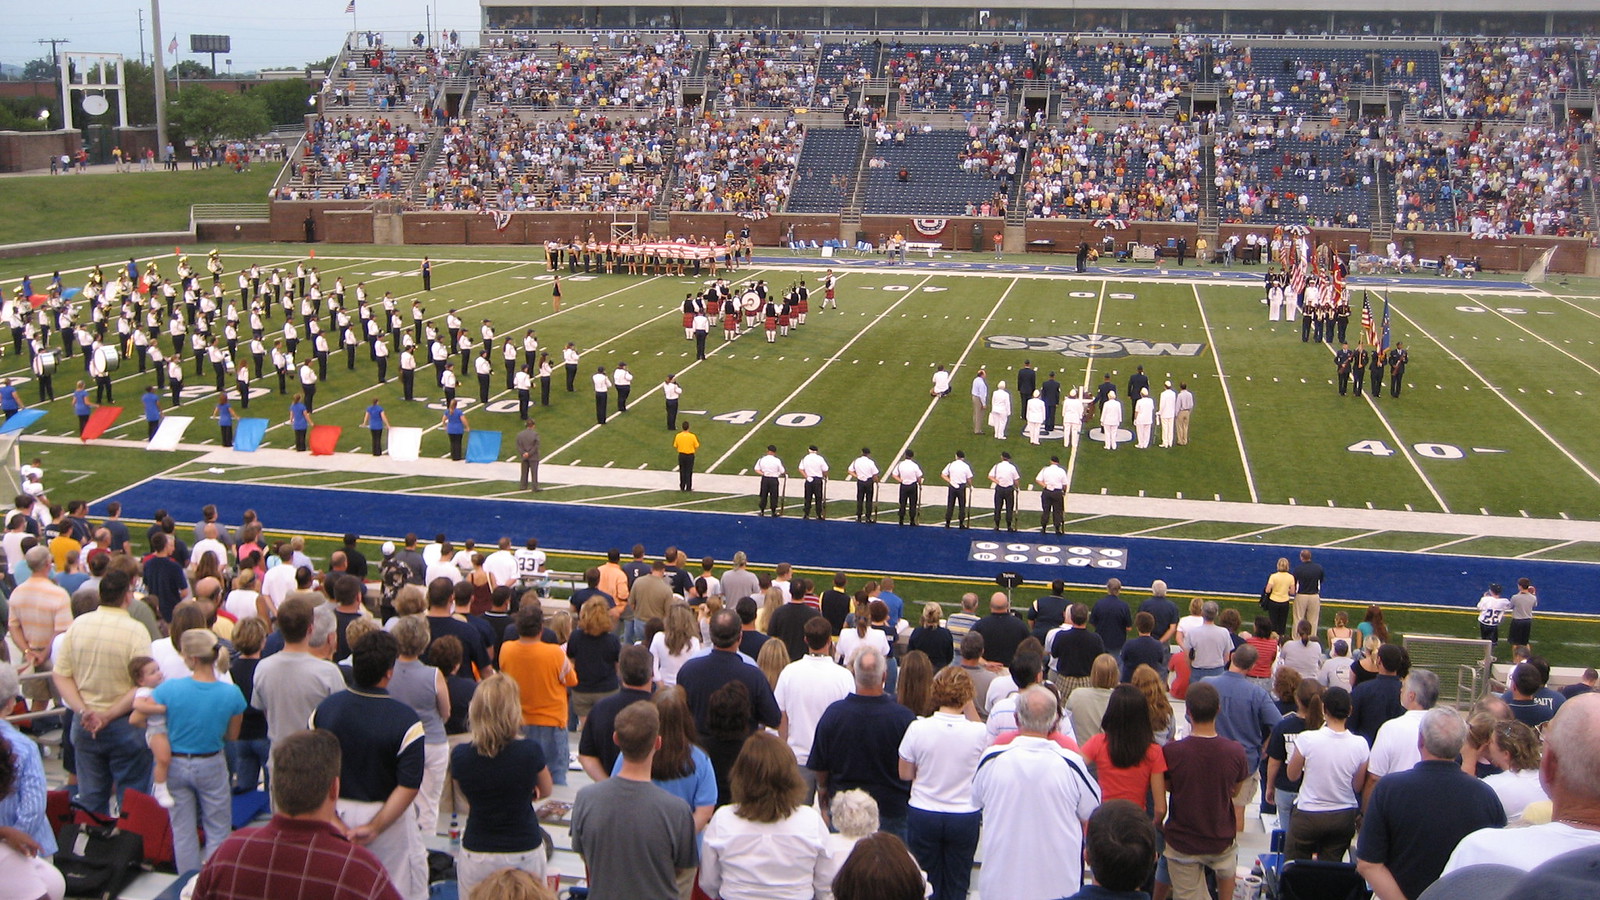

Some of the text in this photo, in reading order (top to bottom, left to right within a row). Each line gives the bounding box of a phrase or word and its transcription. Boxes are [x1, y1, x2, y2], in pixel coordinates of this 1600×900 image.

[987, 333, 1202, 357] MOCS
[711, 410, 822, 427] 40
[1347, 440, 1466, 459] 40
[519, 557, 535, 571] 33
[1483, 608, 1502, 625] 22
